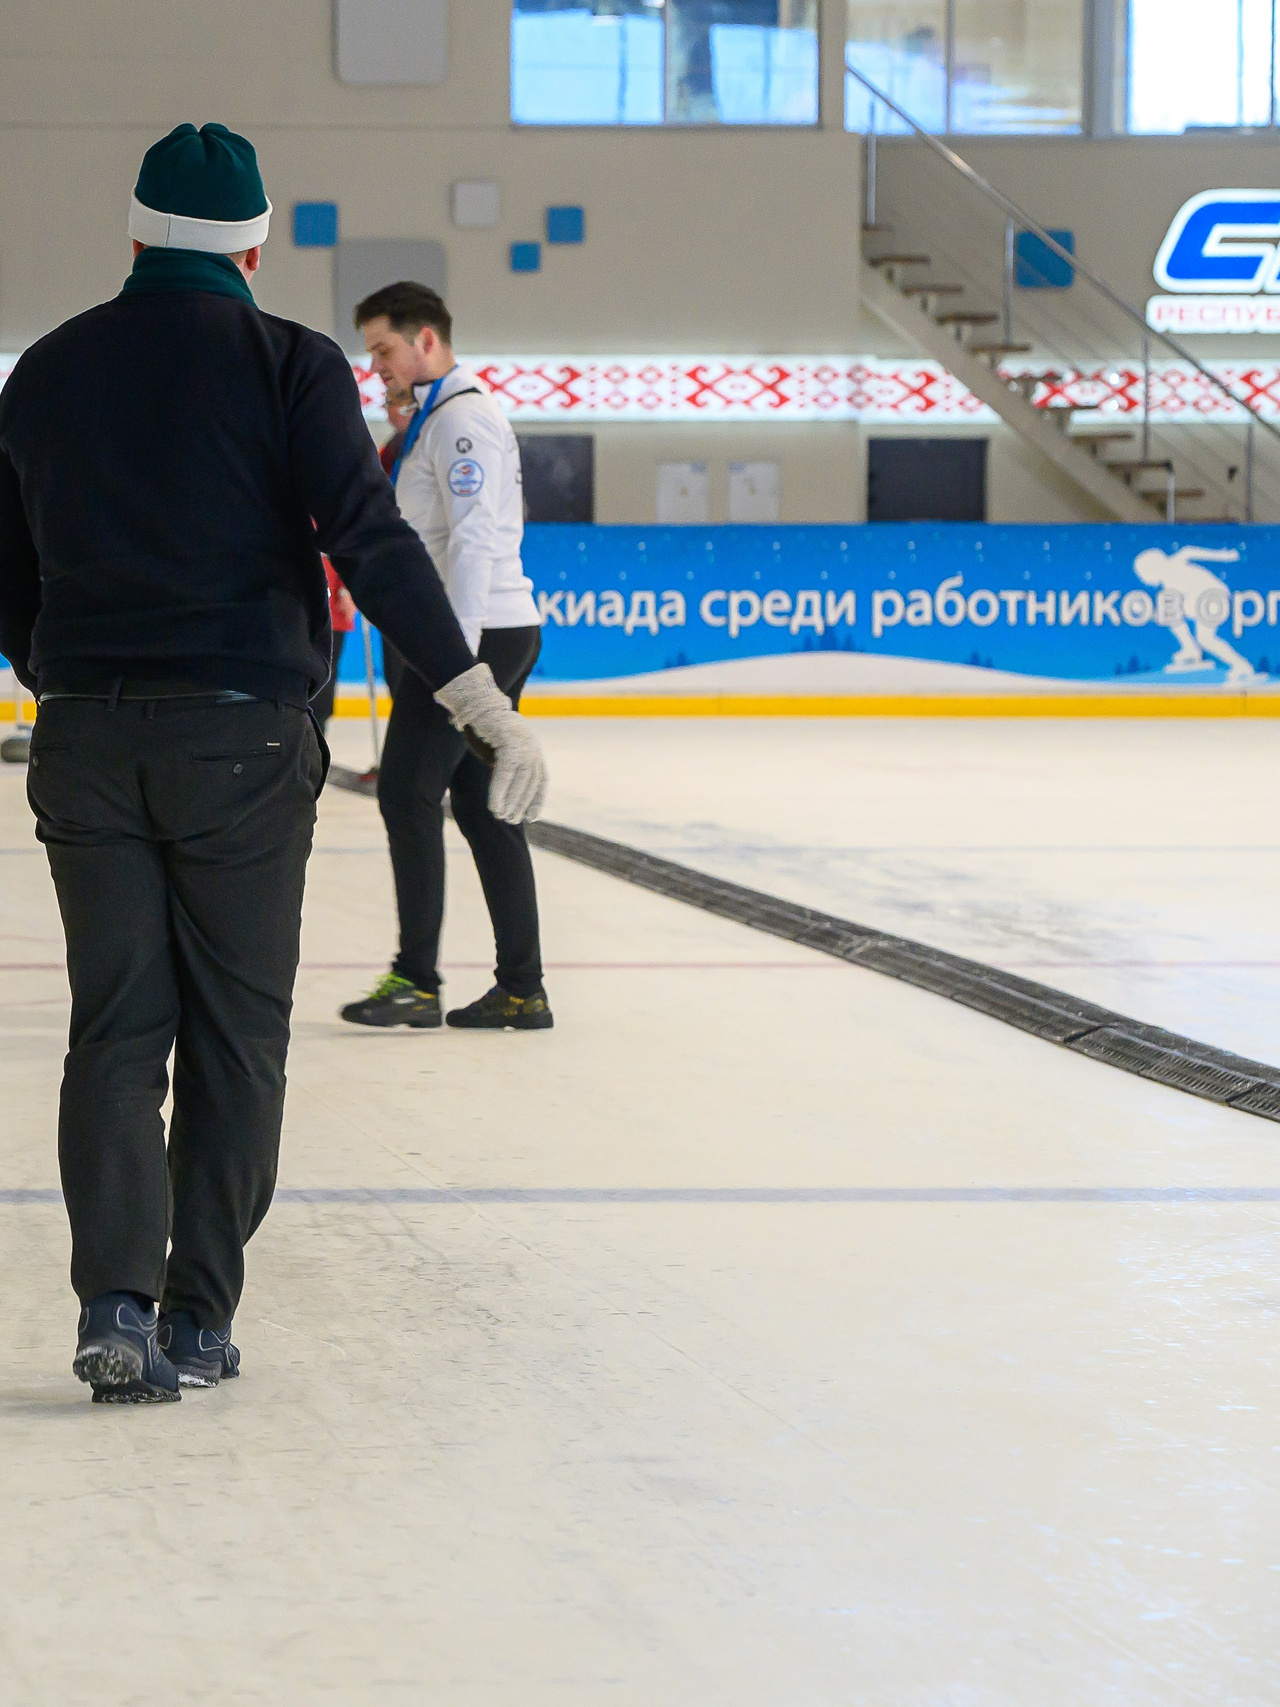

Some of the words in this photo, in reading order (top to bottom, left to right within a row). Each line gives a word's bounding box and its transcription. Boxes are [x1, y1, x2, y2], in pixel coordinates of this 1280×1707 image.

[537, 589, 687, 636] киада
[699, 589, 857, 639] среди
[871, 574, 1185, 638] работников
